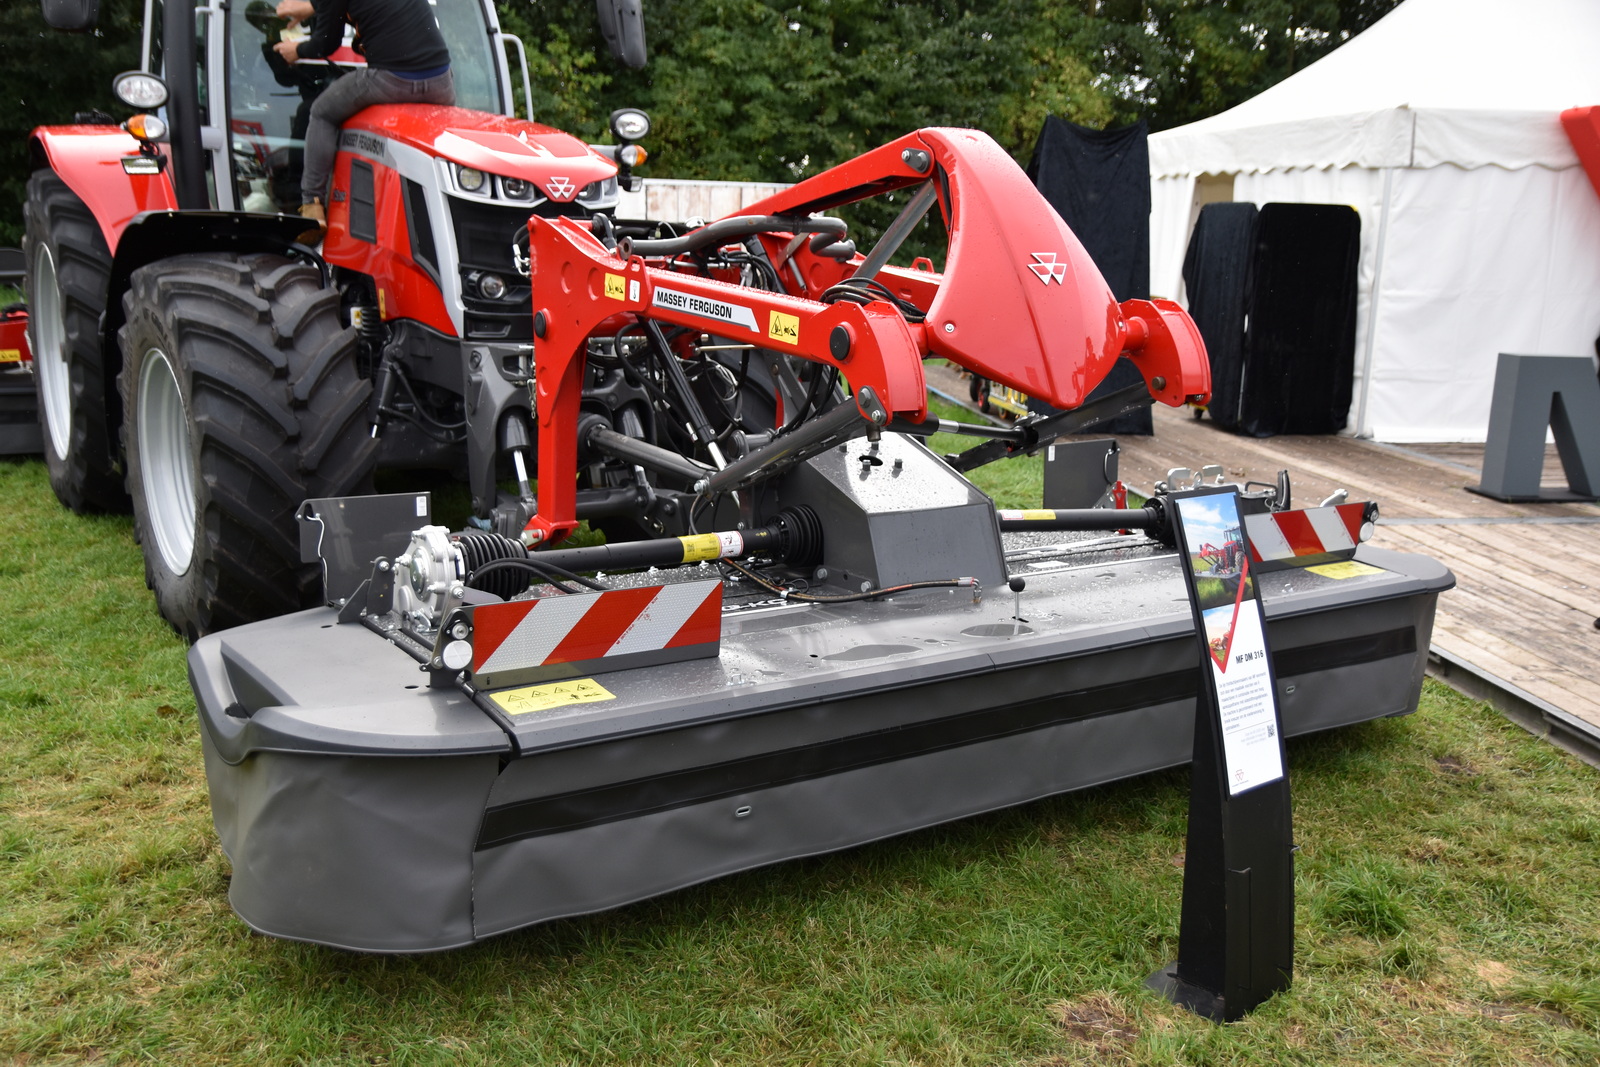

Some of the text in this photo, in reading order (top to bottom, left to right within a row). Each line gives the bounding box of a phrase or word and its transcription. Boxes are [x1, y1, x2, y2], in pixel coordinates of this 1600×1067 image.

[359, 134, 385, 157] FERGUSON
[657, 291, 732, 318] MASSEY FERGUSON
[1236, 649, 1264, 664] MF DM 316
